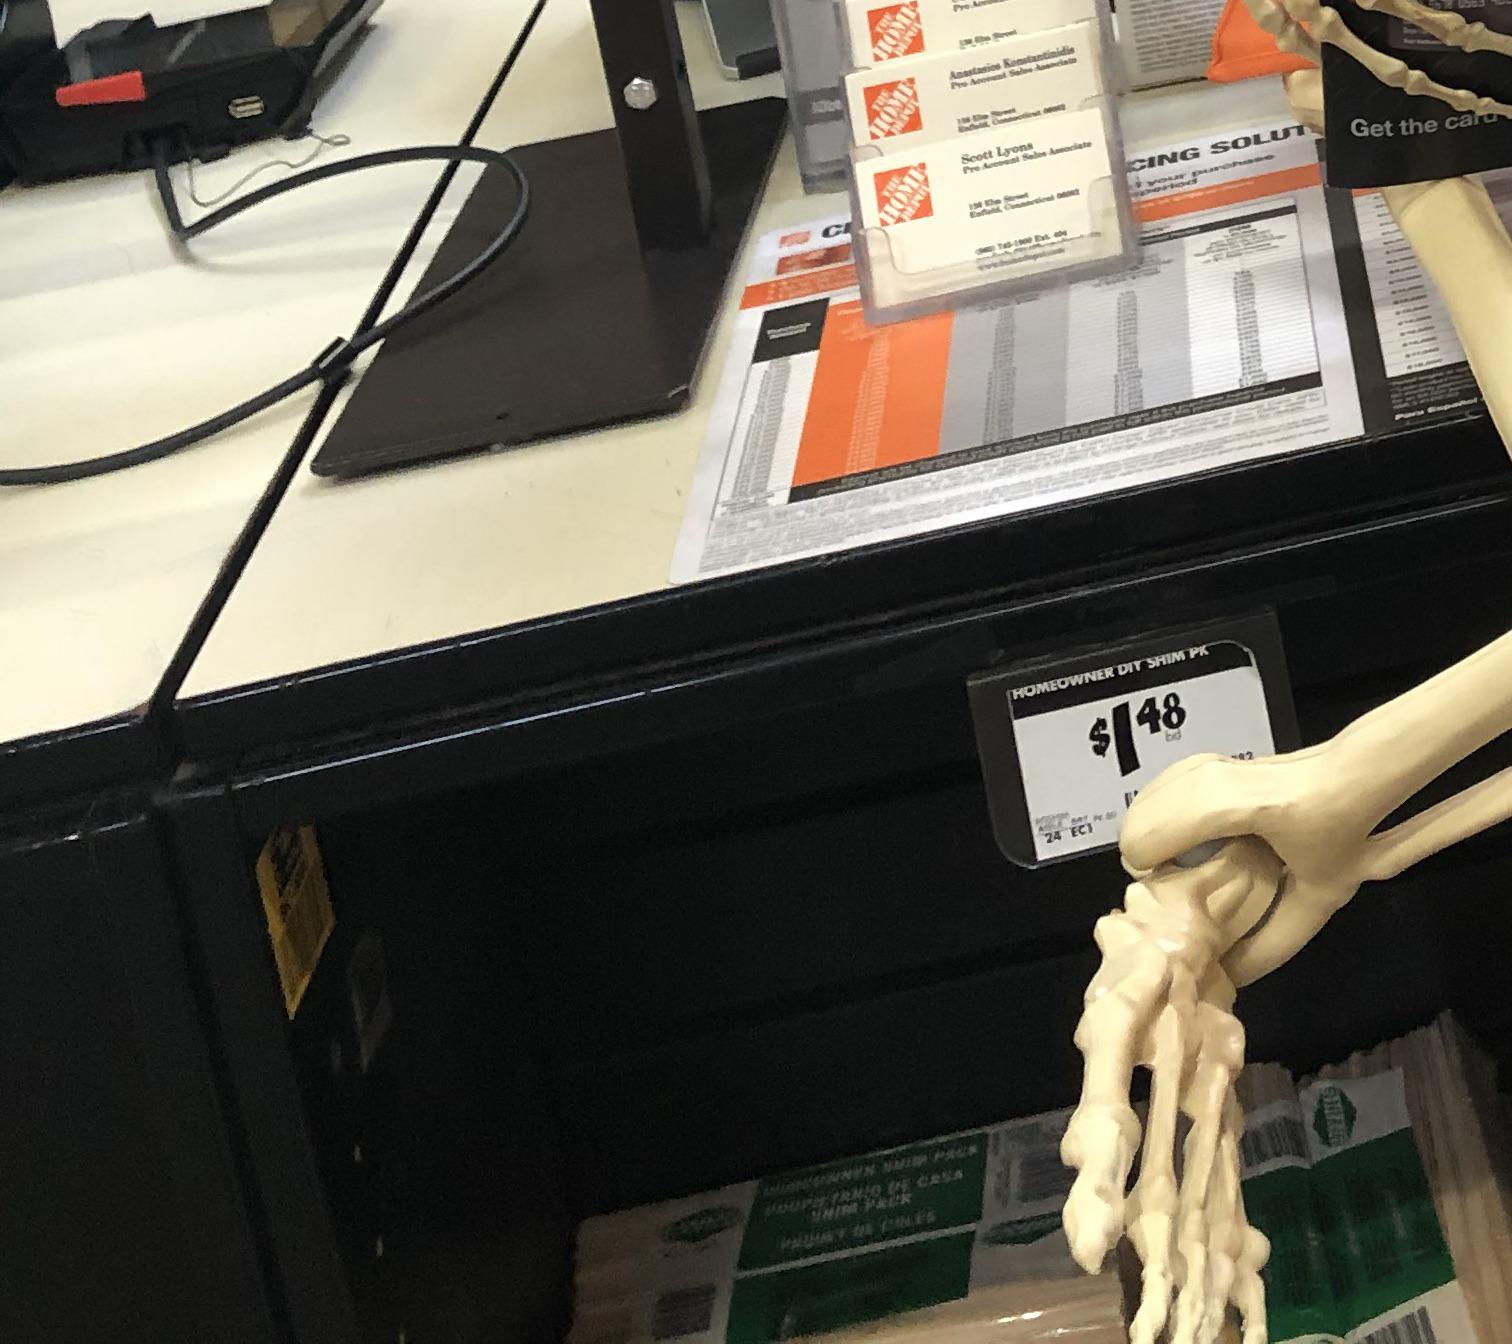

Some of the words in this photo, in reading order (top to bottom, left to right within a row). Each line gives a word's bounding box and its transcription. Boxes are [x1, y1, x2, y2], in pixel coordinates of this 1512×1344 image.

[1350, 118, 1394, 138] Get
[1398, 116, 1438, 136] the
[961, 149, 994, 165] Scott
[996, 142, 1034, 158] Lyons
[963, 165, 980, 174] Pro
[983, 156, 1020, 170] Account
[1022, 151, 1047, 161] Sales
[1049, 141, 1092, 156] Associate
[1191, 153, 1275, 178] purchase
[879, 163, 929, 226] HOME
[1012, 666, 1115, 701] HOMEOWNER
[1117, 660, 1142, 678] DIY
[1147, 649, 1187, 670] SHIM
[1189, 644, 1210, 659] PK
[1044, 830, 1062, 844] 24
